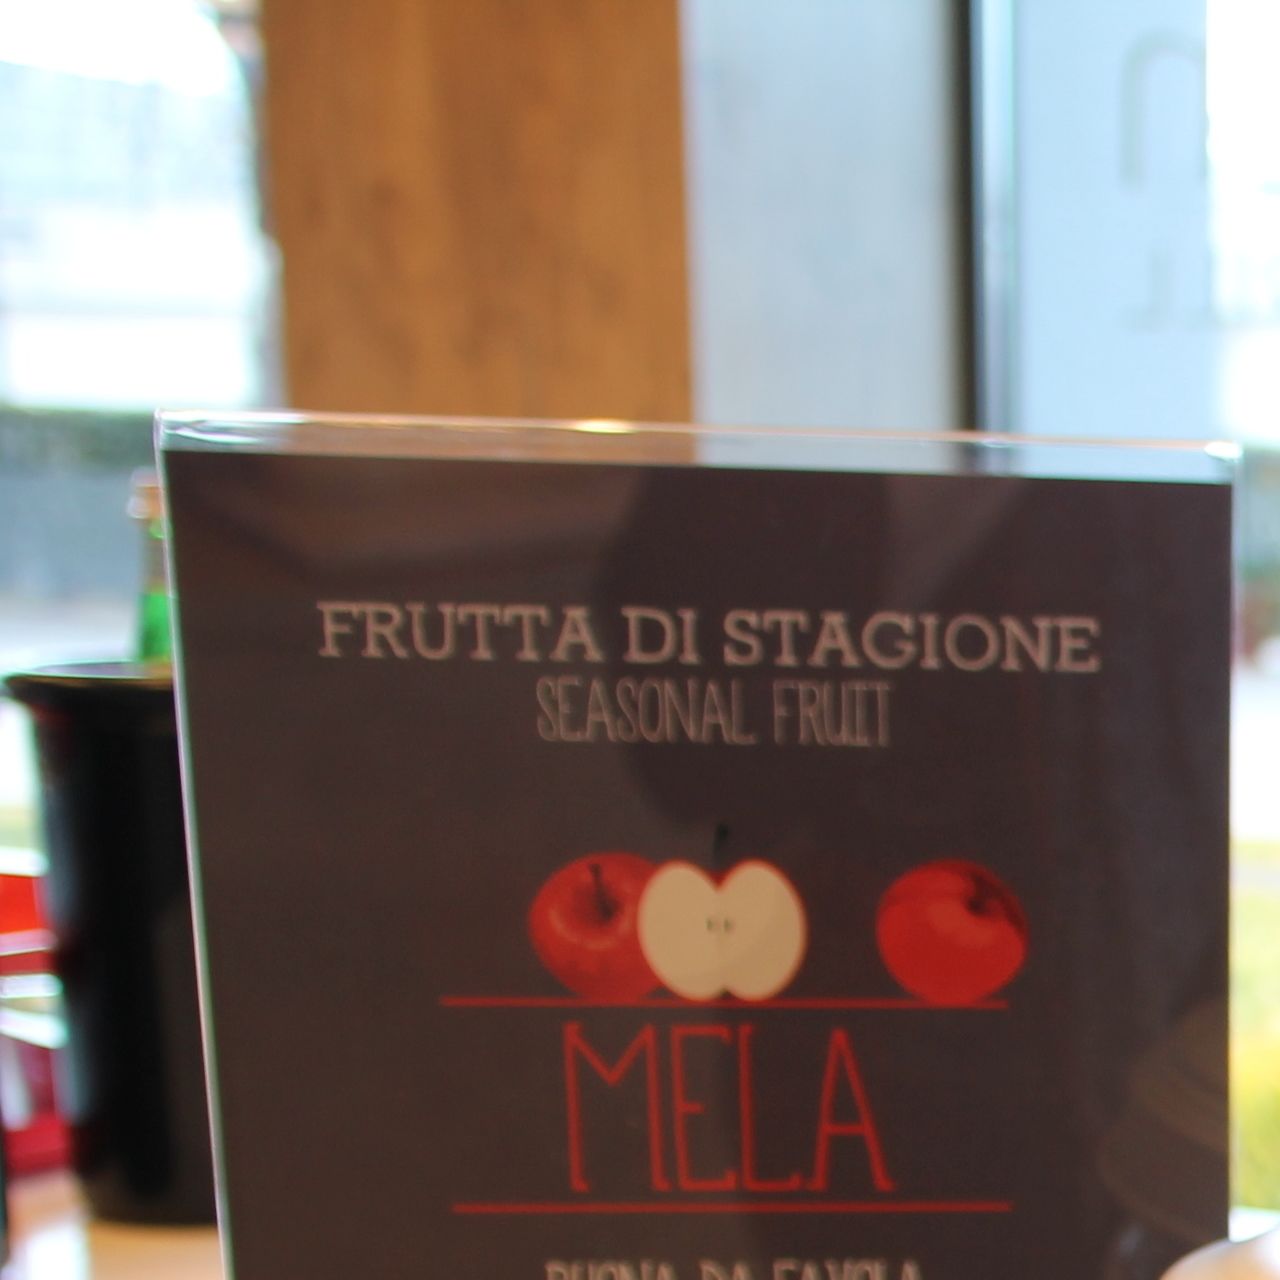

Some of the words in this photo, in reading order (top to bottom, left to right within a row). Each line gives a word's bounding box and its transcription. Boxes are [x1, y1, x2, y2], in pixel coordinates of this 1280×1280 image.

[317, 602, 601, 664] FRUTTA
[622, 605, 698, 665] DI
[722, 608, 1102, 675] STAGIONE
[535, 675, 757, 745] SEASONAL
[772, 678, 891, 748] FRUIT
[562, 1020, 896, 1194] MELA
